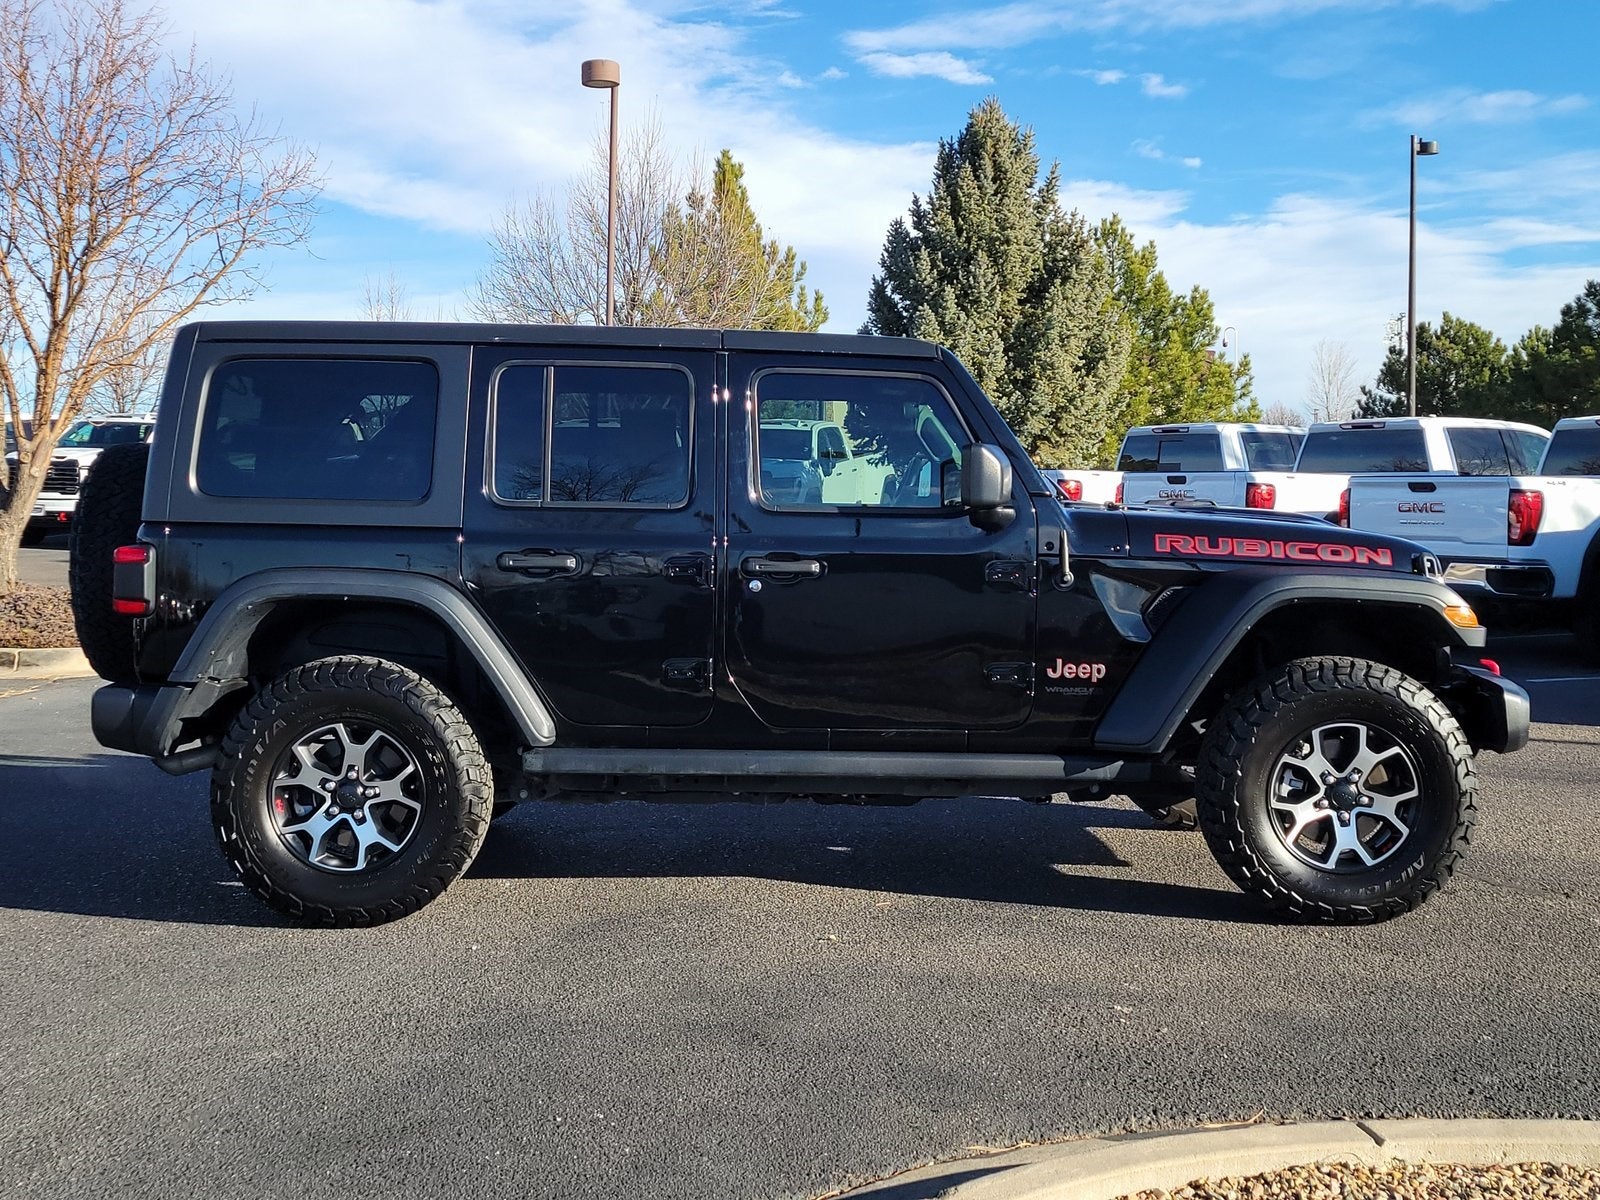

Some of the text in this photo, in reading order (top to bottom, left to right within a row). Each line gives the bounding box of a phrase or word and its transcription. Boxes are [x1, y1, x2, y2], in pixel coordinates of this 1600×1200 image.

[1158, 489, 1196, 499] GMC
[1397, 502, 1446, 514] GMC
[1154, 533, 1393, 566] RUBICON
[1046, 658, 1106, 683] Jeep
